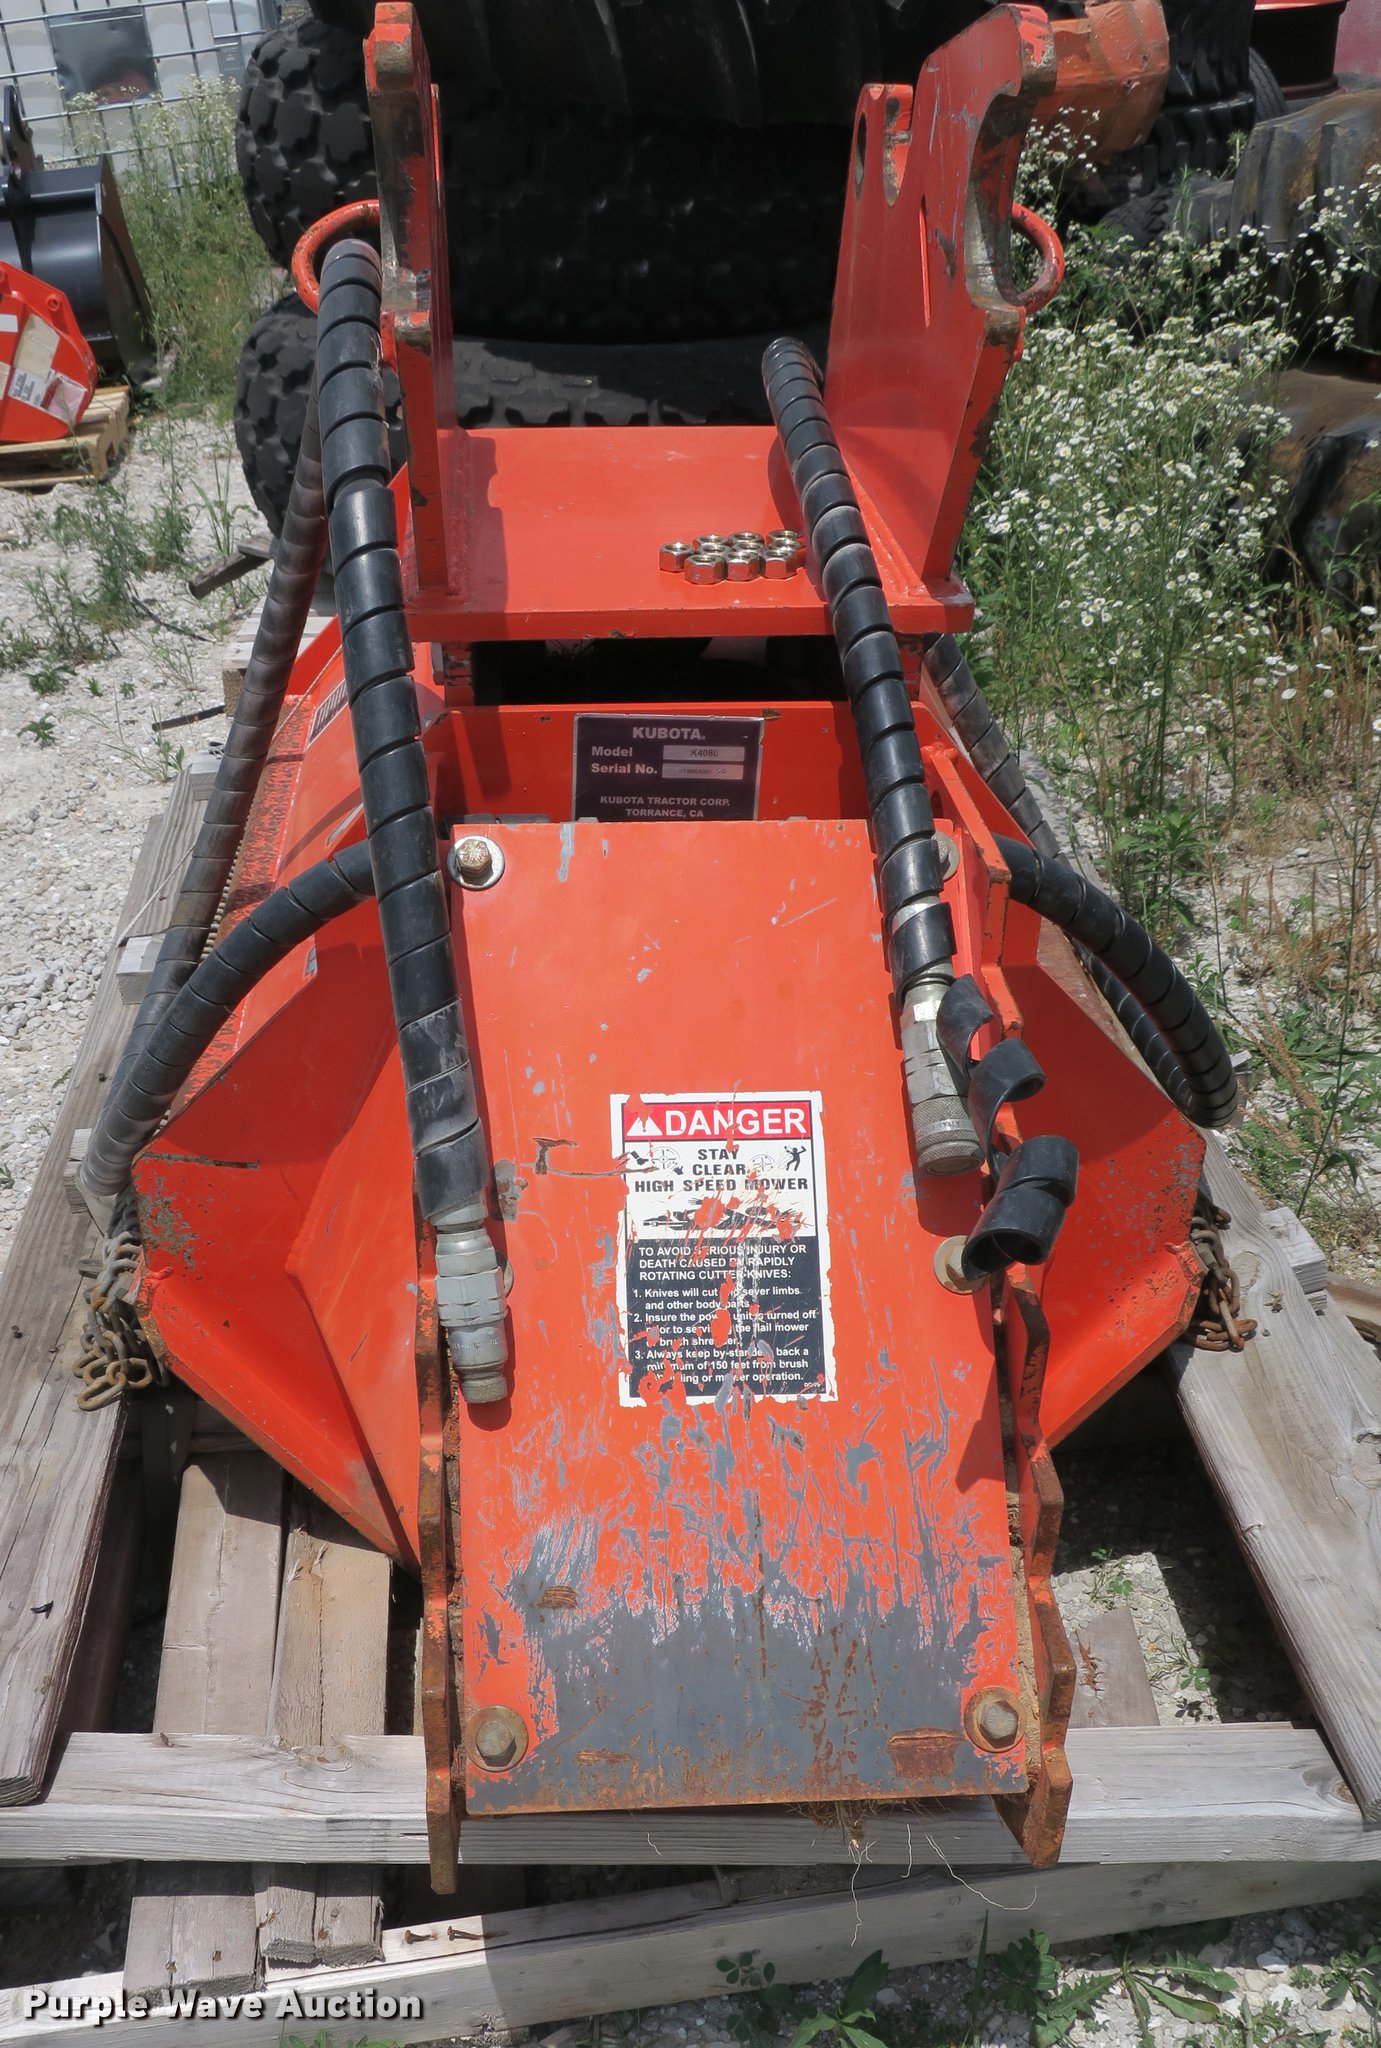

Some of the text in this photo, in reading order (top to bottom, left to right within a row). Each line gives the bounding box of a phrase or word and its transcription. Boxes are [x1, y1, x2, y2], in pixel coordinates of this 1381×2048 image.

[592, 746, 633, 757] Model
[591, 762, 658, 775] Serial No.
[600, 796, 731, 807] KUBOTA TRACTOR CORP.
[626, 808, 704, 819] TORRANCE, CA
[665, 1108, 807, 1136] DANGER
[697, 1148, 739, 1160] STAY
[692, 1164, 746, 1176] CLEAR
[635, 1177, 808, 1193] HIGH SPEED MOWER
[639, 1247, 654, 1256] TO
[657, 1246, 691, 1256] AVOID
[747, 1245, 786, 1255] INJURY
[790, 1244, 806, 1254] OR
[640, 1259, 676, 1269] DEATH
[748, 1257, 795, 1266] RAPIDLY
[640, 1269, 791, 1280] ROTATING CUTTER KNIVES:
[633, 1289, 642, 1297] 1.
[645, 1288, 679, 1297] Knives
[682, 1288, 699, 1297] will
[702, 1288, 718, 1297] cut
[743, 1288, 770, 1296] sever
[773, 1286, 800, 1295] limbs
[645, 1301, 664, 1310] and
[667, 1301, 693, 1309] other
[696, 1300, 721, 1310] body
[634, 1314, 642, 1322] 2.
[646, 1313, 677, 1322] Insure
[680, 1313, 696, 1321] the
[733, 1311, 752, 1320] unit
[767, 1310, 799, 1320] turned
[802, 1309, 816, 1319] off
[673, 1325, 683, 1334] to
[735, 1323, 751, 1332] the
[754, 1322, 772, 1332] flail
[775, 1323, 809, 1331] mower
[660, 1337, 689, 1346] brh
[635, 1350, 644, 1359] 3.
[646, 1349, 683, 1360] Always
[686, 1349, 710, 1359] keep
[776, 1347, 800, 1356] back
[803, 1348, 809, 1356] a
[647, 1359, 809, 1371] minmum of 150 feet from brush
[715, 1374, 750, 1382] mer
[752, 1372, 804, 1383] operation.
